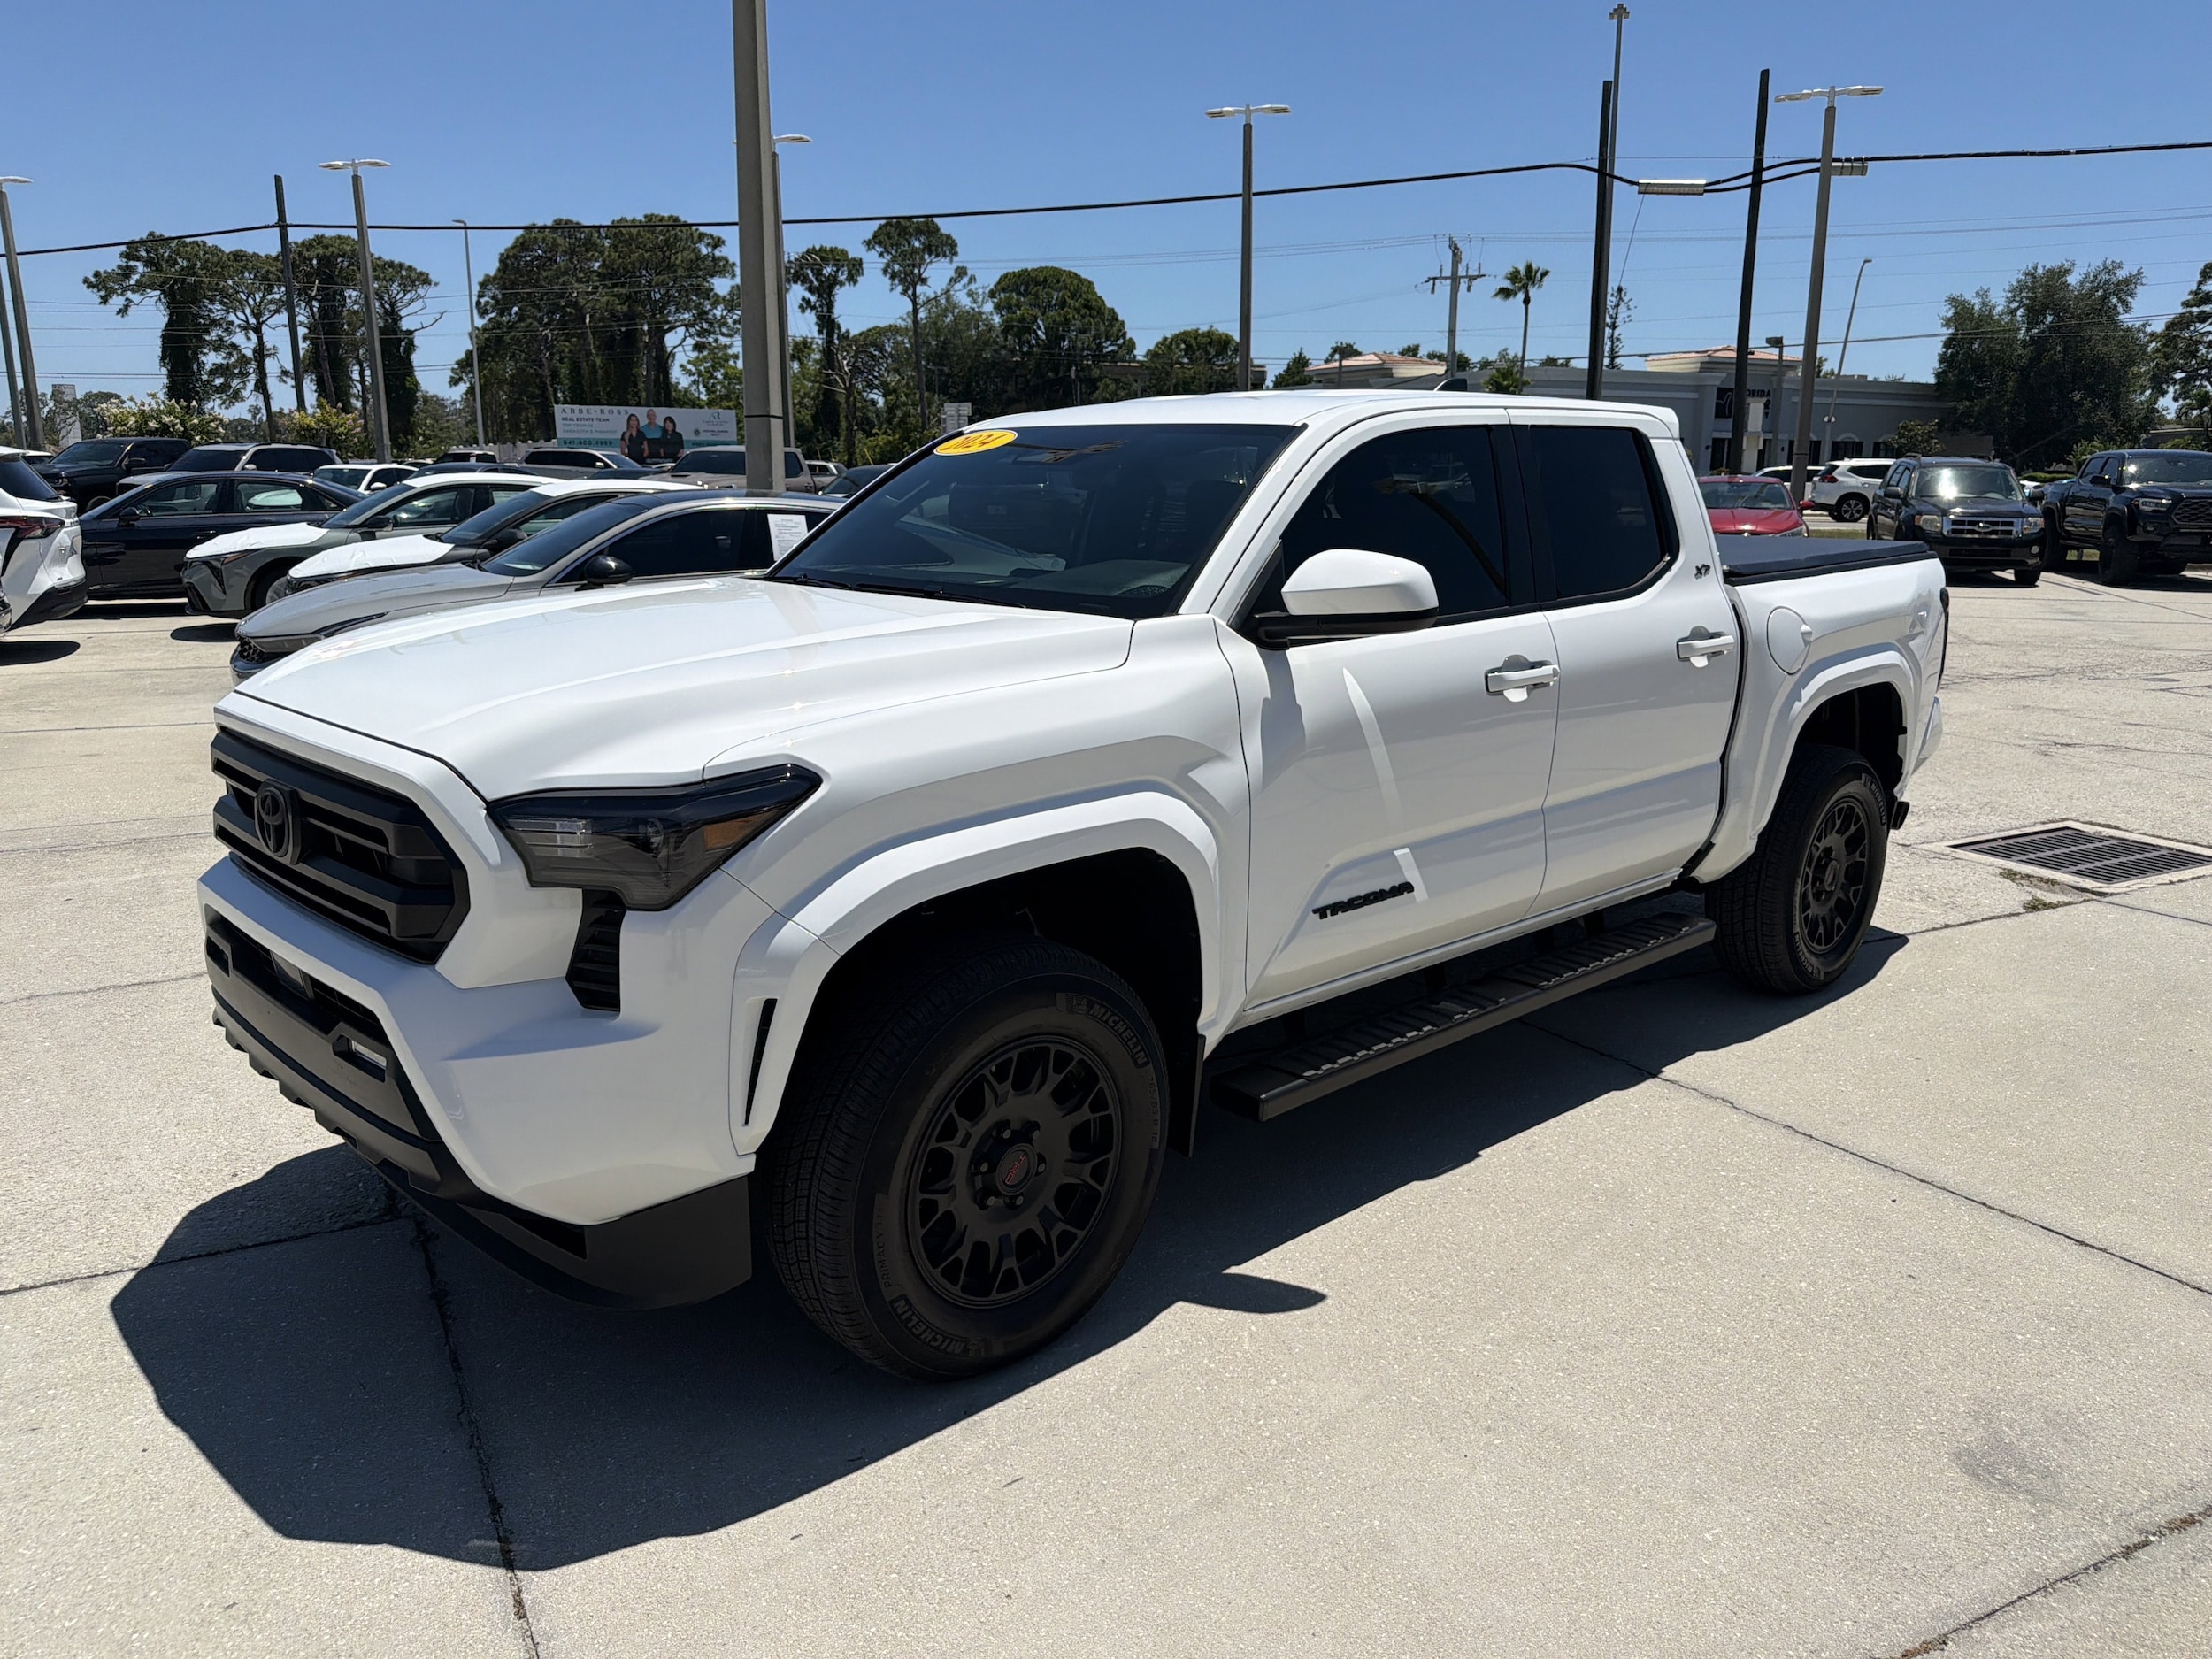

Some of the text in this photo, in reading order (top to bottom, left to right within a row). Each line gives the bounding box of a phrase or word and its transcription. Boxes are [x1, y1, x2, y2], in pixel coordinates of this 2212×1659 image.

[1311, 881, 1415, 920] TACOMA
[1089, 1004, 1148, 1064] MICHELIN
[1004, 1154, 1027, 1185] TRD
[876, 1233, 892, 1288] PRIMACY
[894, 1299, 965, 1354] MICHELIN
